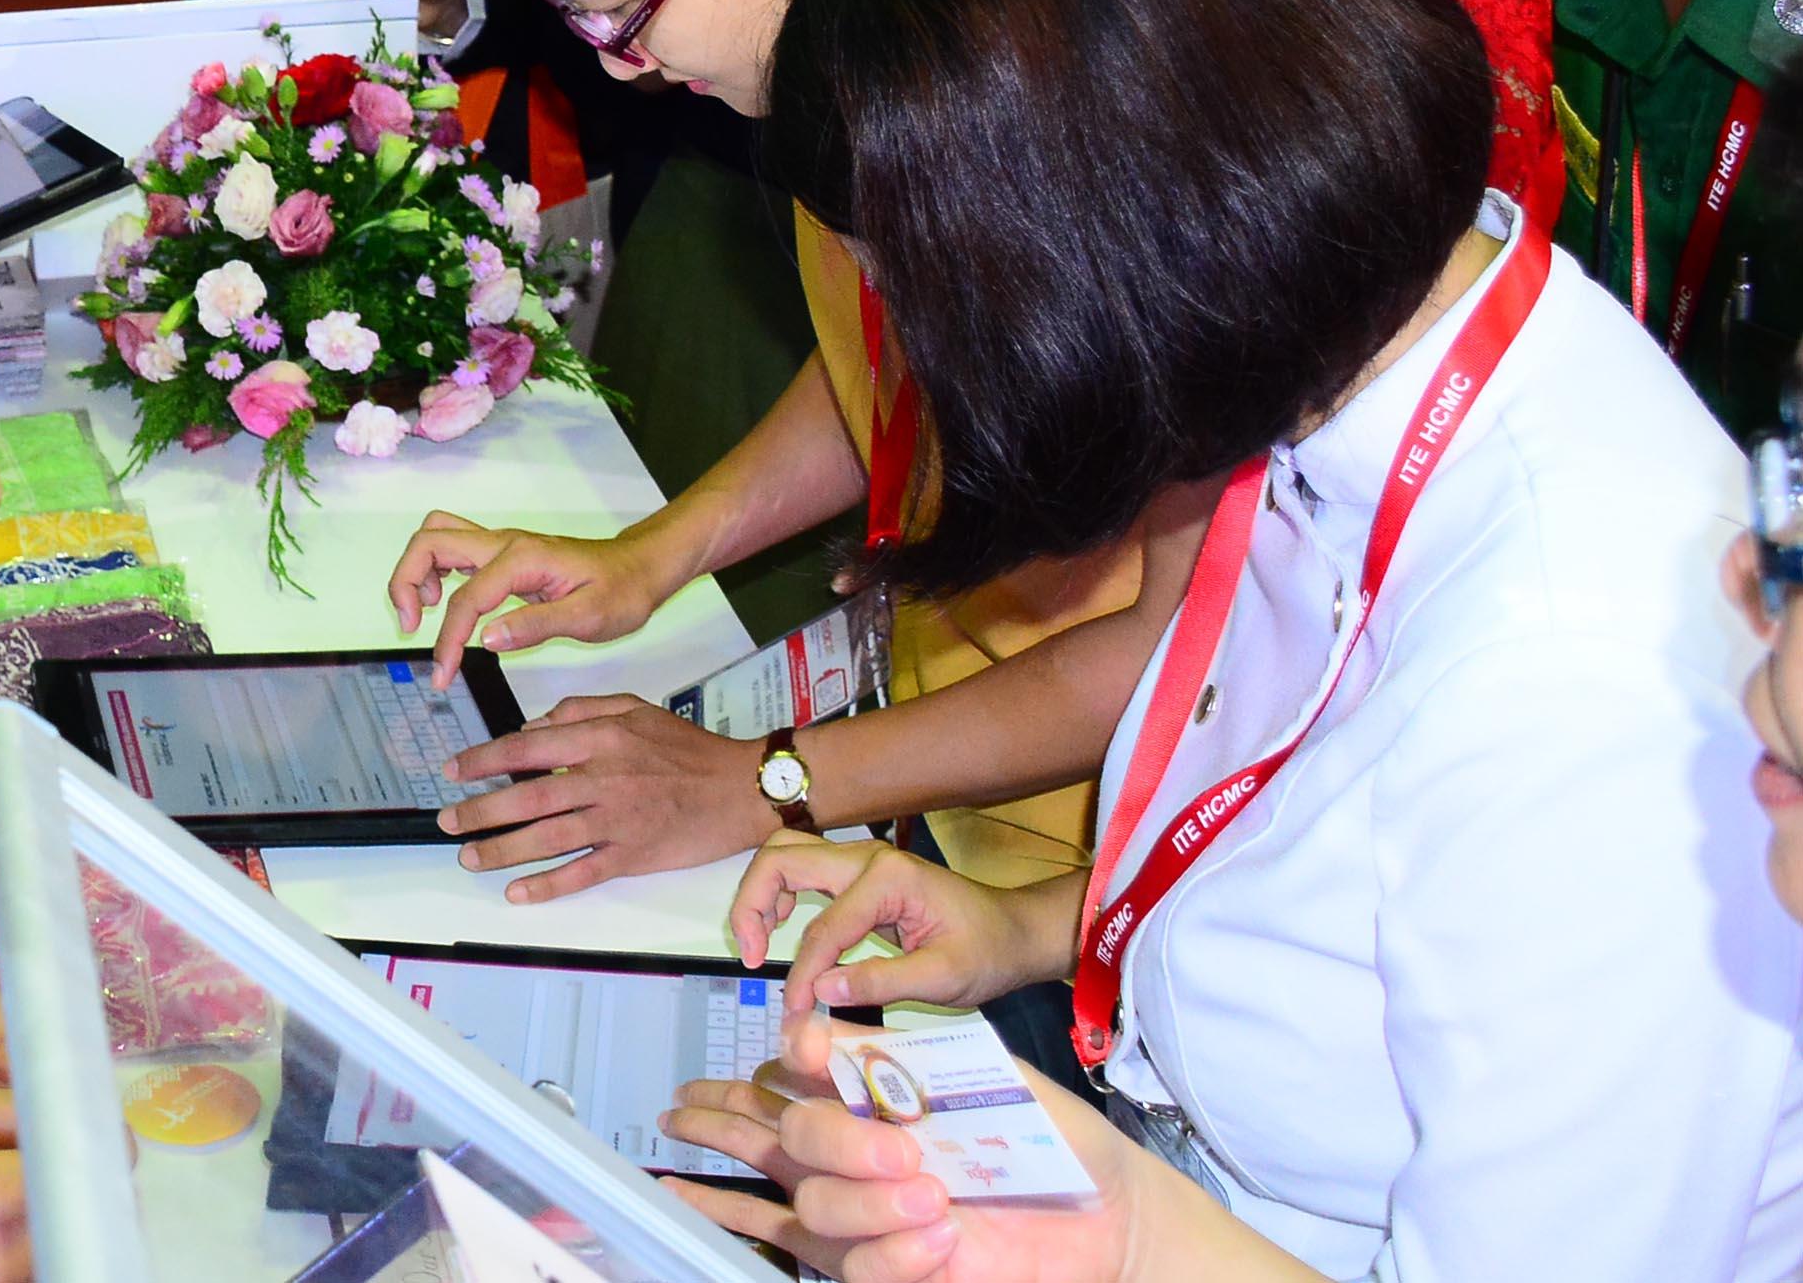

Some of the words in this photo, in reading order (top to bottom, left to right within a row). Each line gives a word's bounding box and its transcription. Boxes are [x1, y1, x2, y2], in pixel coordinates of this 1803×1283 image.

[1708, 178, 1726, 212] ITE
[1718, 120, 1747, 180] HCMC
[1670, 285, 1693, 341] HCMC
[1398, 443, 1430, 486] ITE
[1418, 371, 1472, 445] HCMC
[1171, 818, 1202, 856] ITE
[1196, 775, 1257, 829] HCMC
[1096, 940, 1114, 968] ITE
[1101, 902, 1134, 949] HCMC
